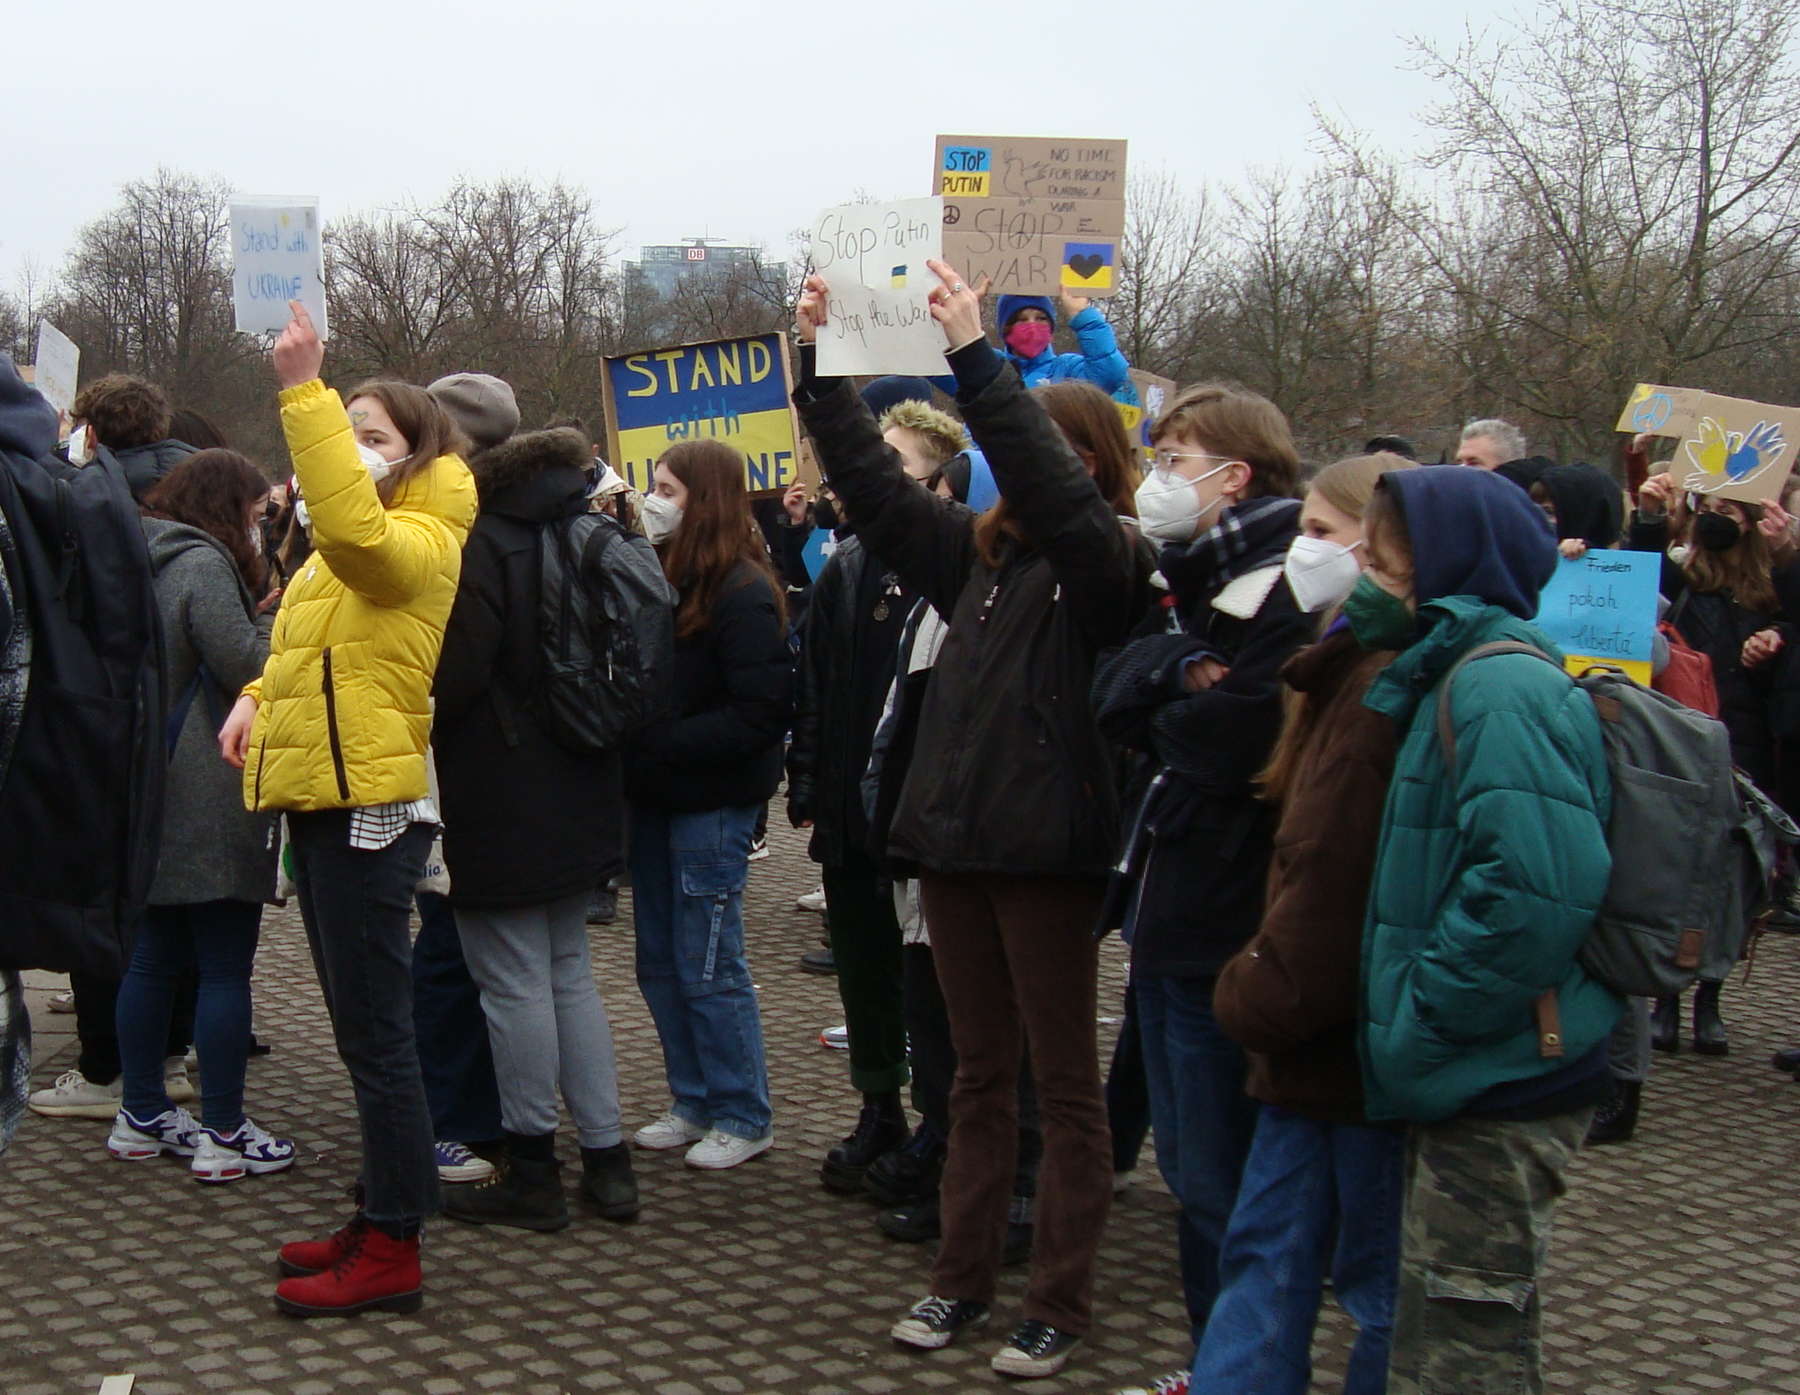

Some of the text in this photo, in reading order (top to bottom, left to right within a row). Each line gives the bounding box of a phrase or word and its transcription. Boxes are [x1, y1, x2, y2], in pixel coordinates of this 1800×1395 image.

[1050, 148, 1115, 162] NO TIME
[942, 175, 983, 193] PUTIN
[1048, 167, 1117, 182] FOR RACISM
[240, 222, 309, 254] Stand with
[818, 210, 930, 287] Stop Putin
[690, 250, 703, 259] DB
[247, 272, 302, 301] UKRAINE
[967, 255, 1048, 288] WAR
[829, 298, 868, 349] Stop
[869, 299, 894, 329] the
[624, 341, 771, 397] STAND
[665, 397, 740, 441] with
[1585, 556, 1632, 574] Frieden
